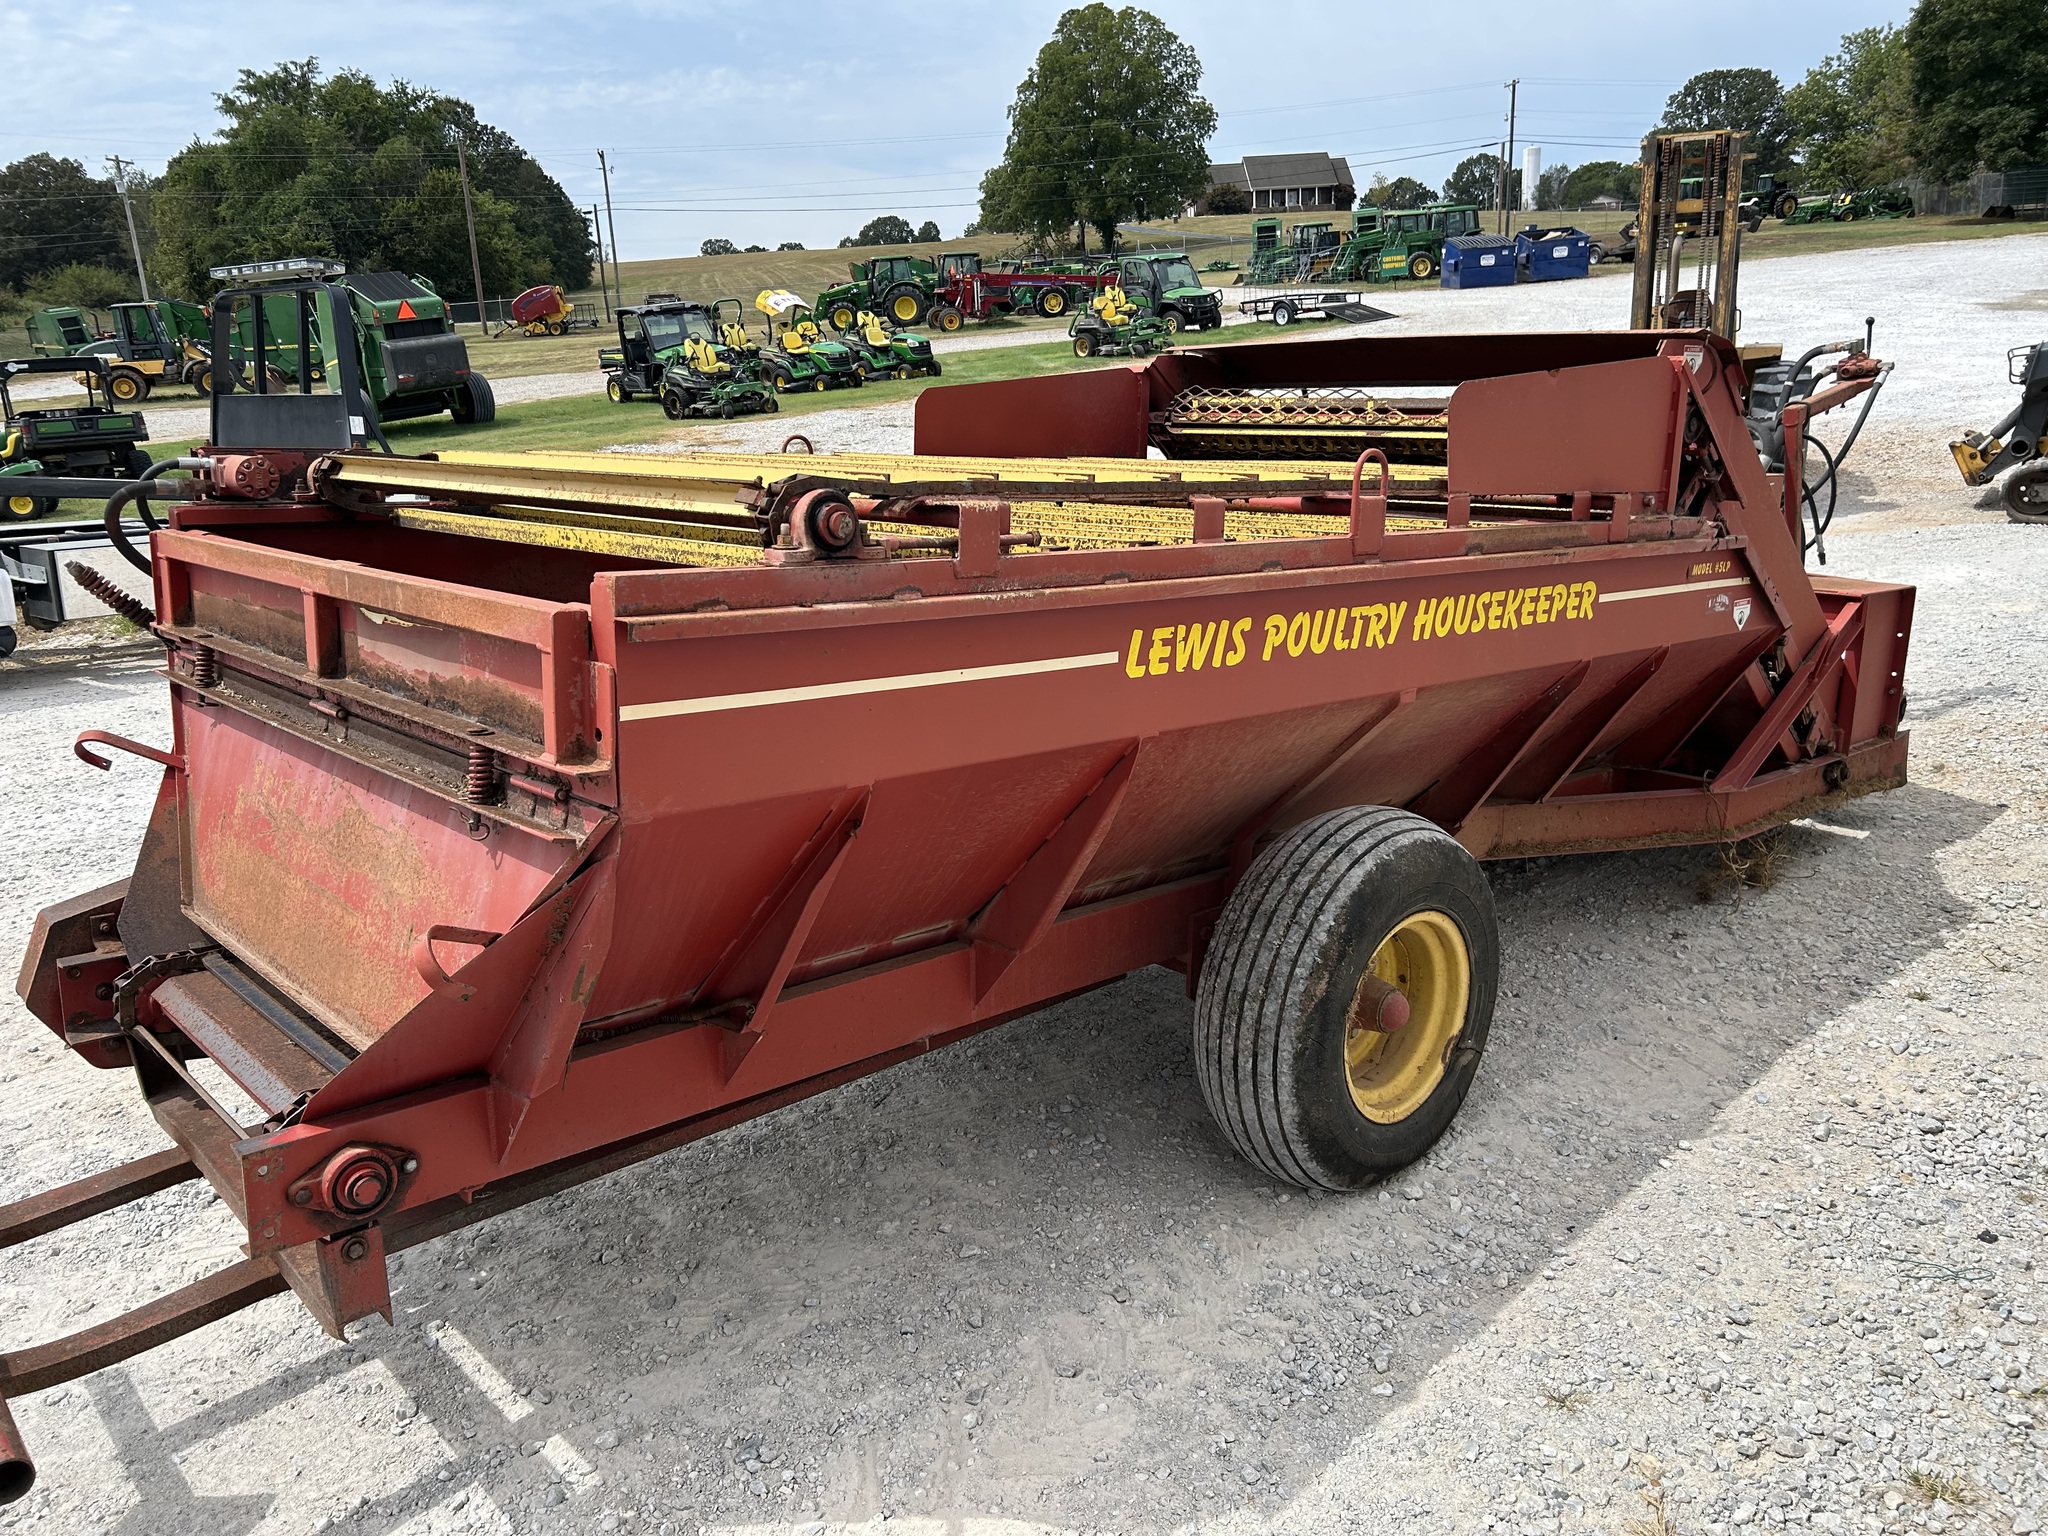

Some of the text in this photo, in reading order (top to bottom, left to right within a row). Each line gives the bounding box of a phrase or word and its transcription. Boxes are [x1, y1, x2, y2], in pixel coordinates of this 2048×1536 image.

[1383, 261, 1406, 269] EQUIPMENT
[1692, 563, 1713, 575] MODEL
[1125, 580, 1597, 679] LEWIS POULTRY HOUSEKEEPER
